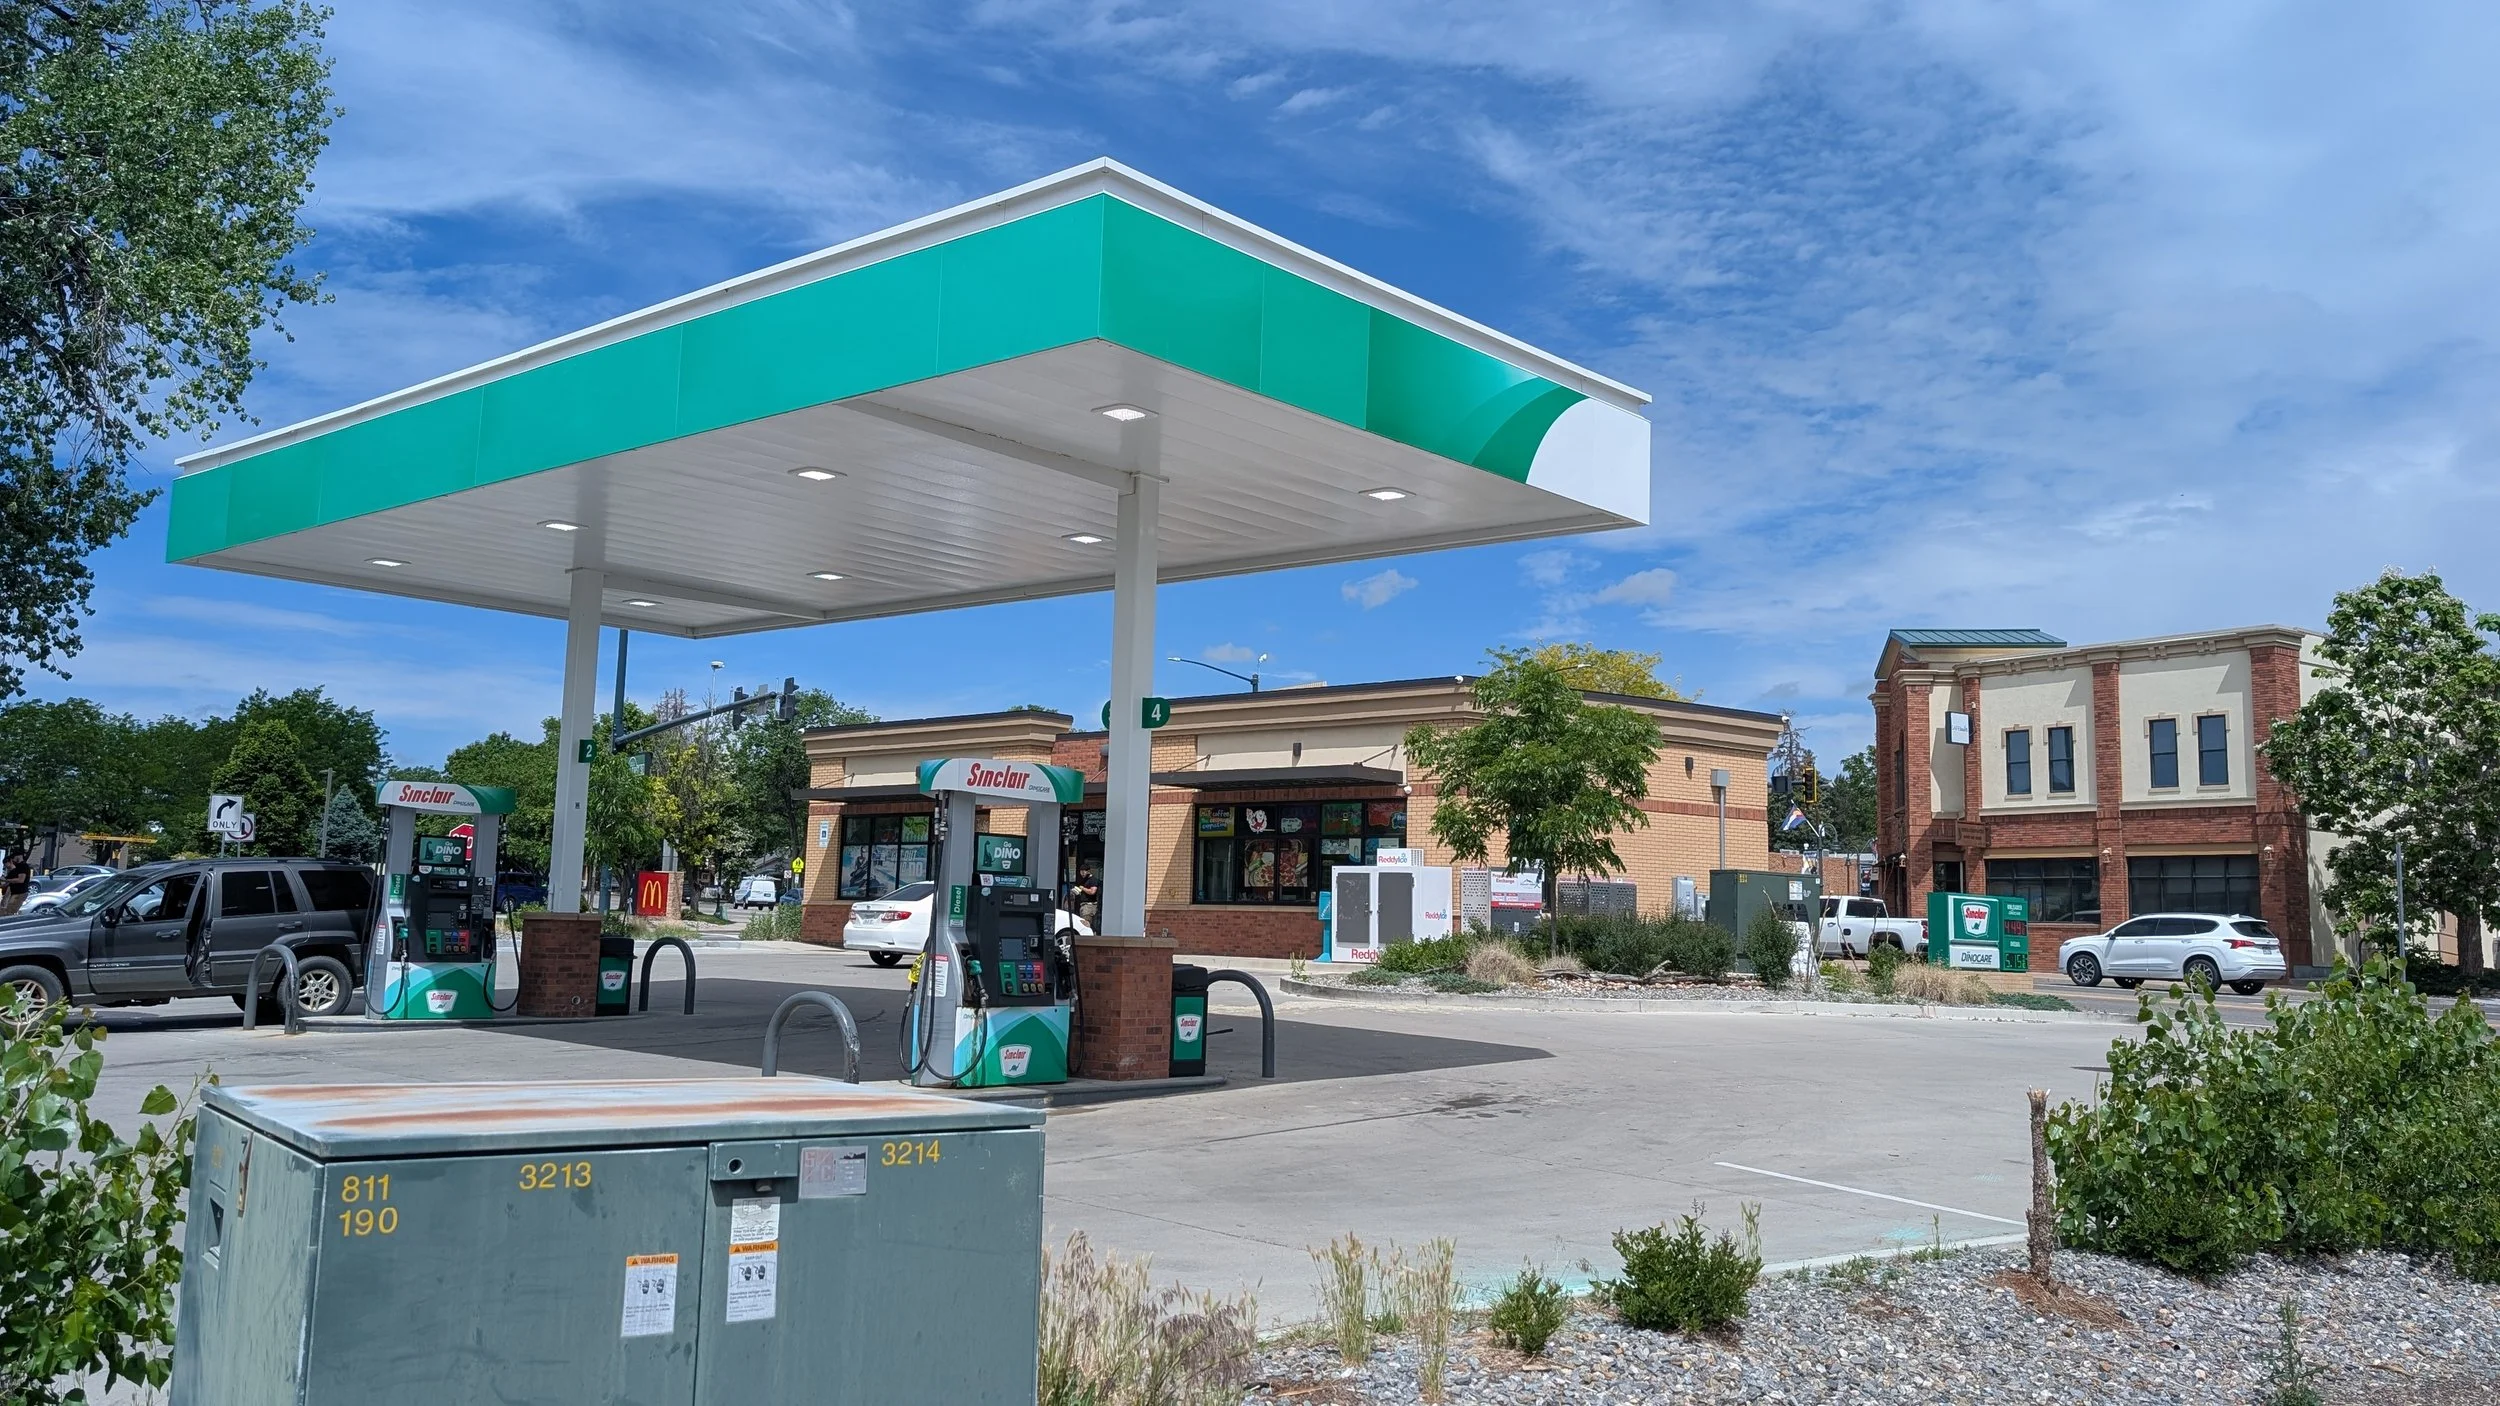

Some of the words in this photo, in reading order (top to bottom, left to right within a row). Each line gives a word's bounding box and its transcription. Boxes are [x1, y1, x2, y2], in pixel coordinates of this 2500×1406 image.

[1151, 703, 1162, 721] 4
[585, 744, 593, 758] 2
[966, 762, 1030, 790] Sinclair
[398, 784, 455, 804] Sinclair
[435, 846, 461, 855] DINO
[993, 847, 1021, 859] DINO
[393, 875, 401, 894] Diesel
[477, 878, 484, 886] 2
[953, 887, 962, 913] Diesel
[1048, 890, 1054, 901] 4
[1965, 907, 1988, 920] Sinclair
[1961, 952, 1992, 963] DINOCARE
[431, 992, 453, 1001] Sinclair
[1004, 1049, 1026, 1060] Sinclair
[881, 1139, 941, 1166] 3214
[518, 1161, 592, 1190] 3213
[341, 1173, 390, 1203] 811
[339, 1206, 398, 1237] 190
[742, 1242, 775, 1252] WARNING
[640, 1255, 675, 1265] WARNING
